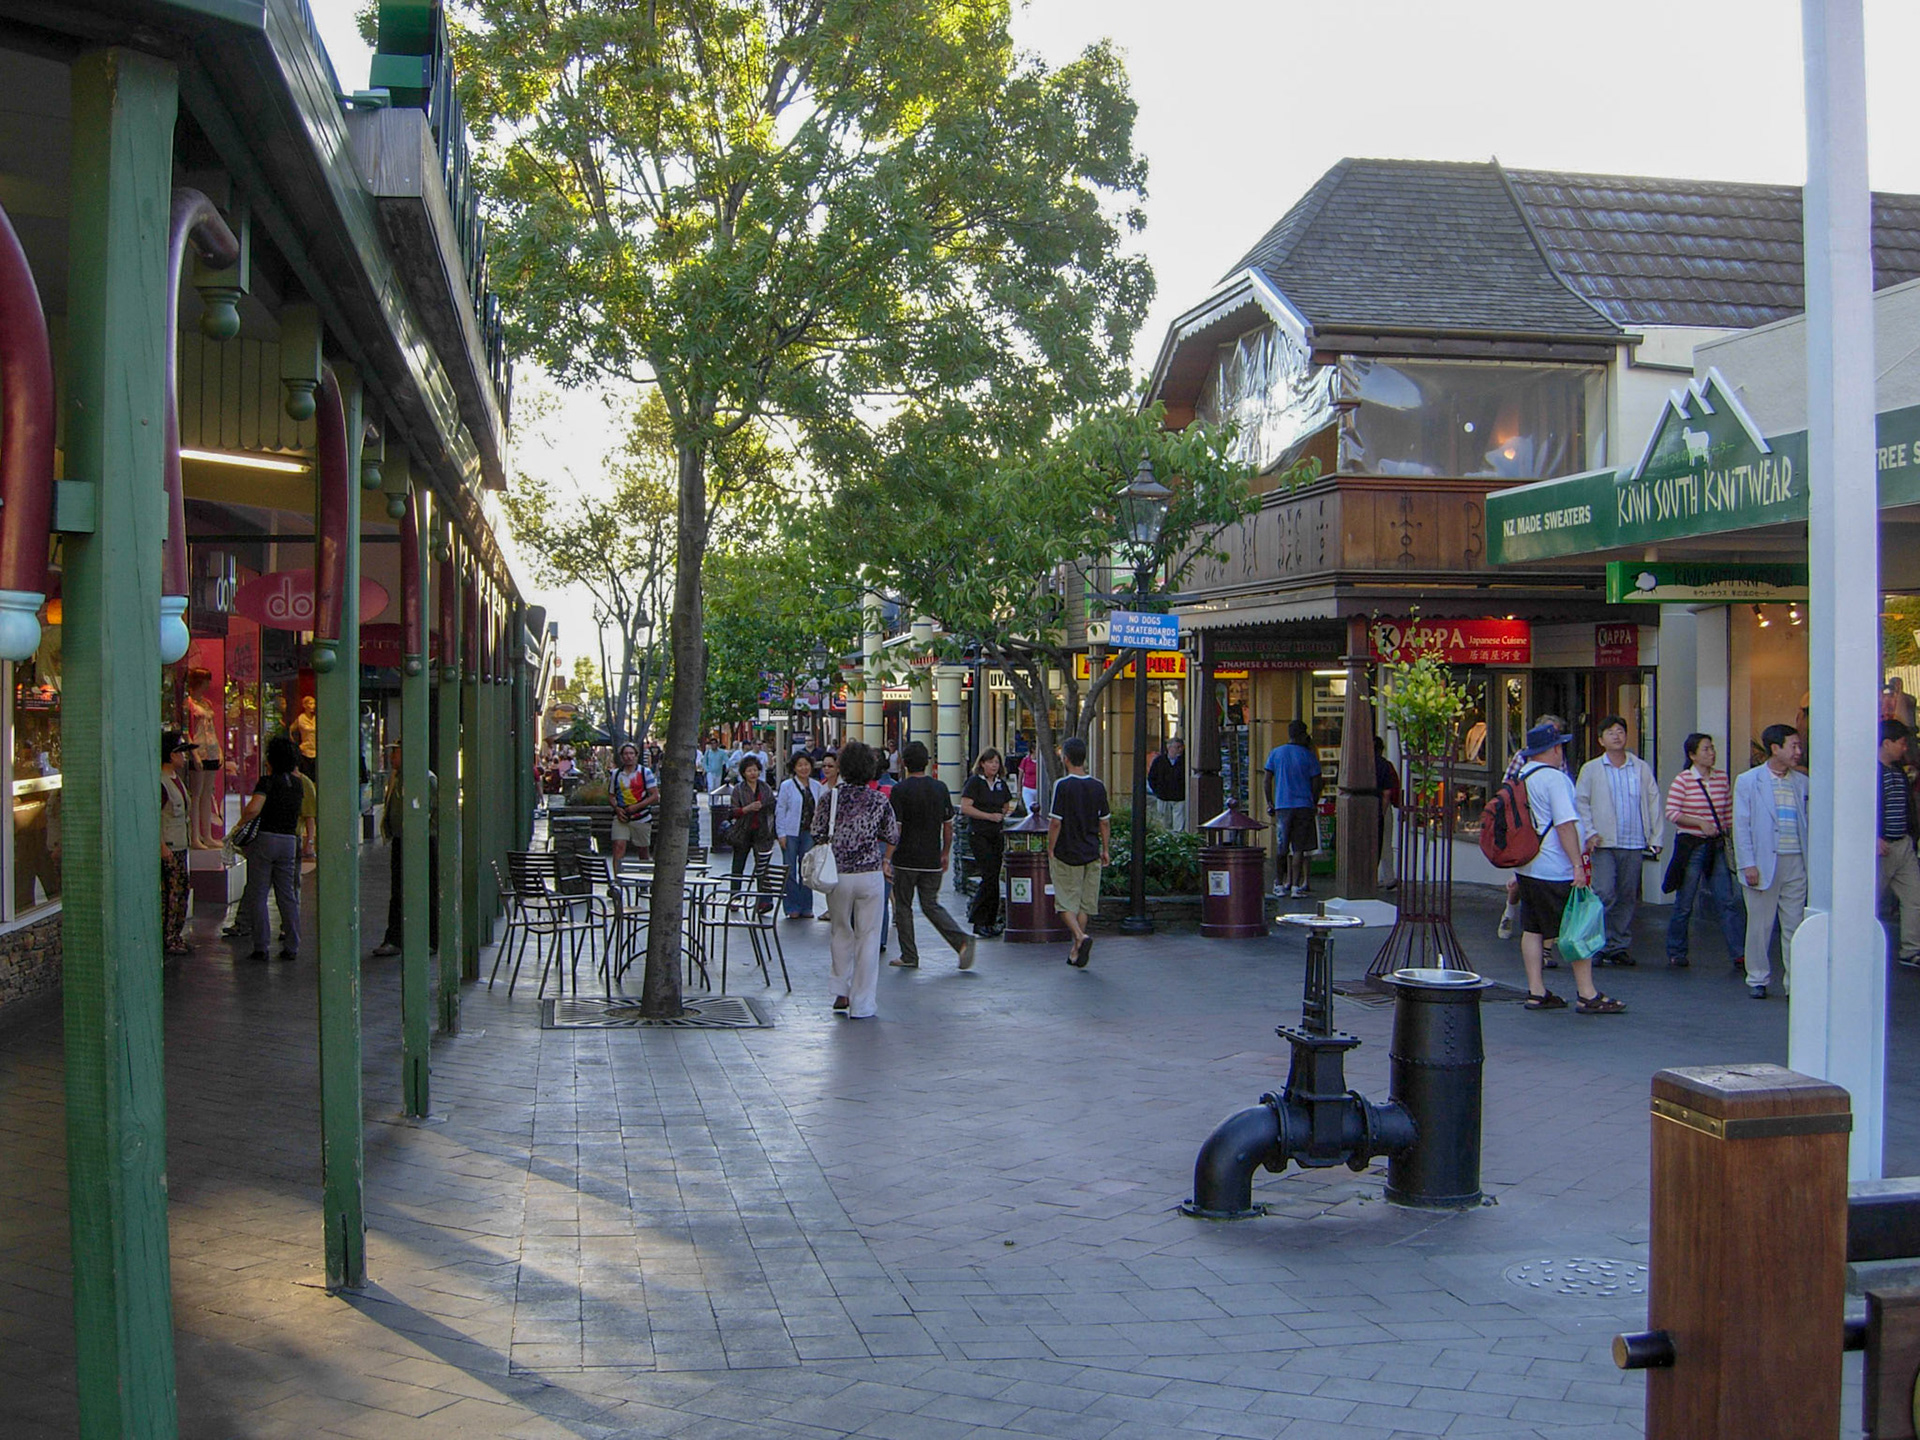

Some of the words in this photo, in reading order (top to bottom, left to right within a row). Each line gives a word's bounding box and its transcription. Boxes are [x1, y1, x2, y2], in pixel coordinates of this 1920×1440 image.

[1876, 443, 1907, 471] REE
[1654, 474, 1698, 522] SOUTH
[1503, 519, 1515, 537] NZ
[1517, 514, 1542, 534] MADE
[1544, 505, 1591, 530] SWEATERS
[1129, 616, 1138, 624] NO
[1141, 616, 1161, 625] DOGS
[1112, 625, 1122, 633] NO
[1126, 625, 1176, 637] SKATEBOARDS
[1381, 627, 1465, 649] KAPPA
[1600, 629, 1632, 645] KAPPA
[1110, 635, 1120, 643] NO
[1123, 636, 1176, 647] ROLLERBLADES
[1468, 636, 1500, 645] Japanese
[1501, 636, 1527, 645] Cuisine
